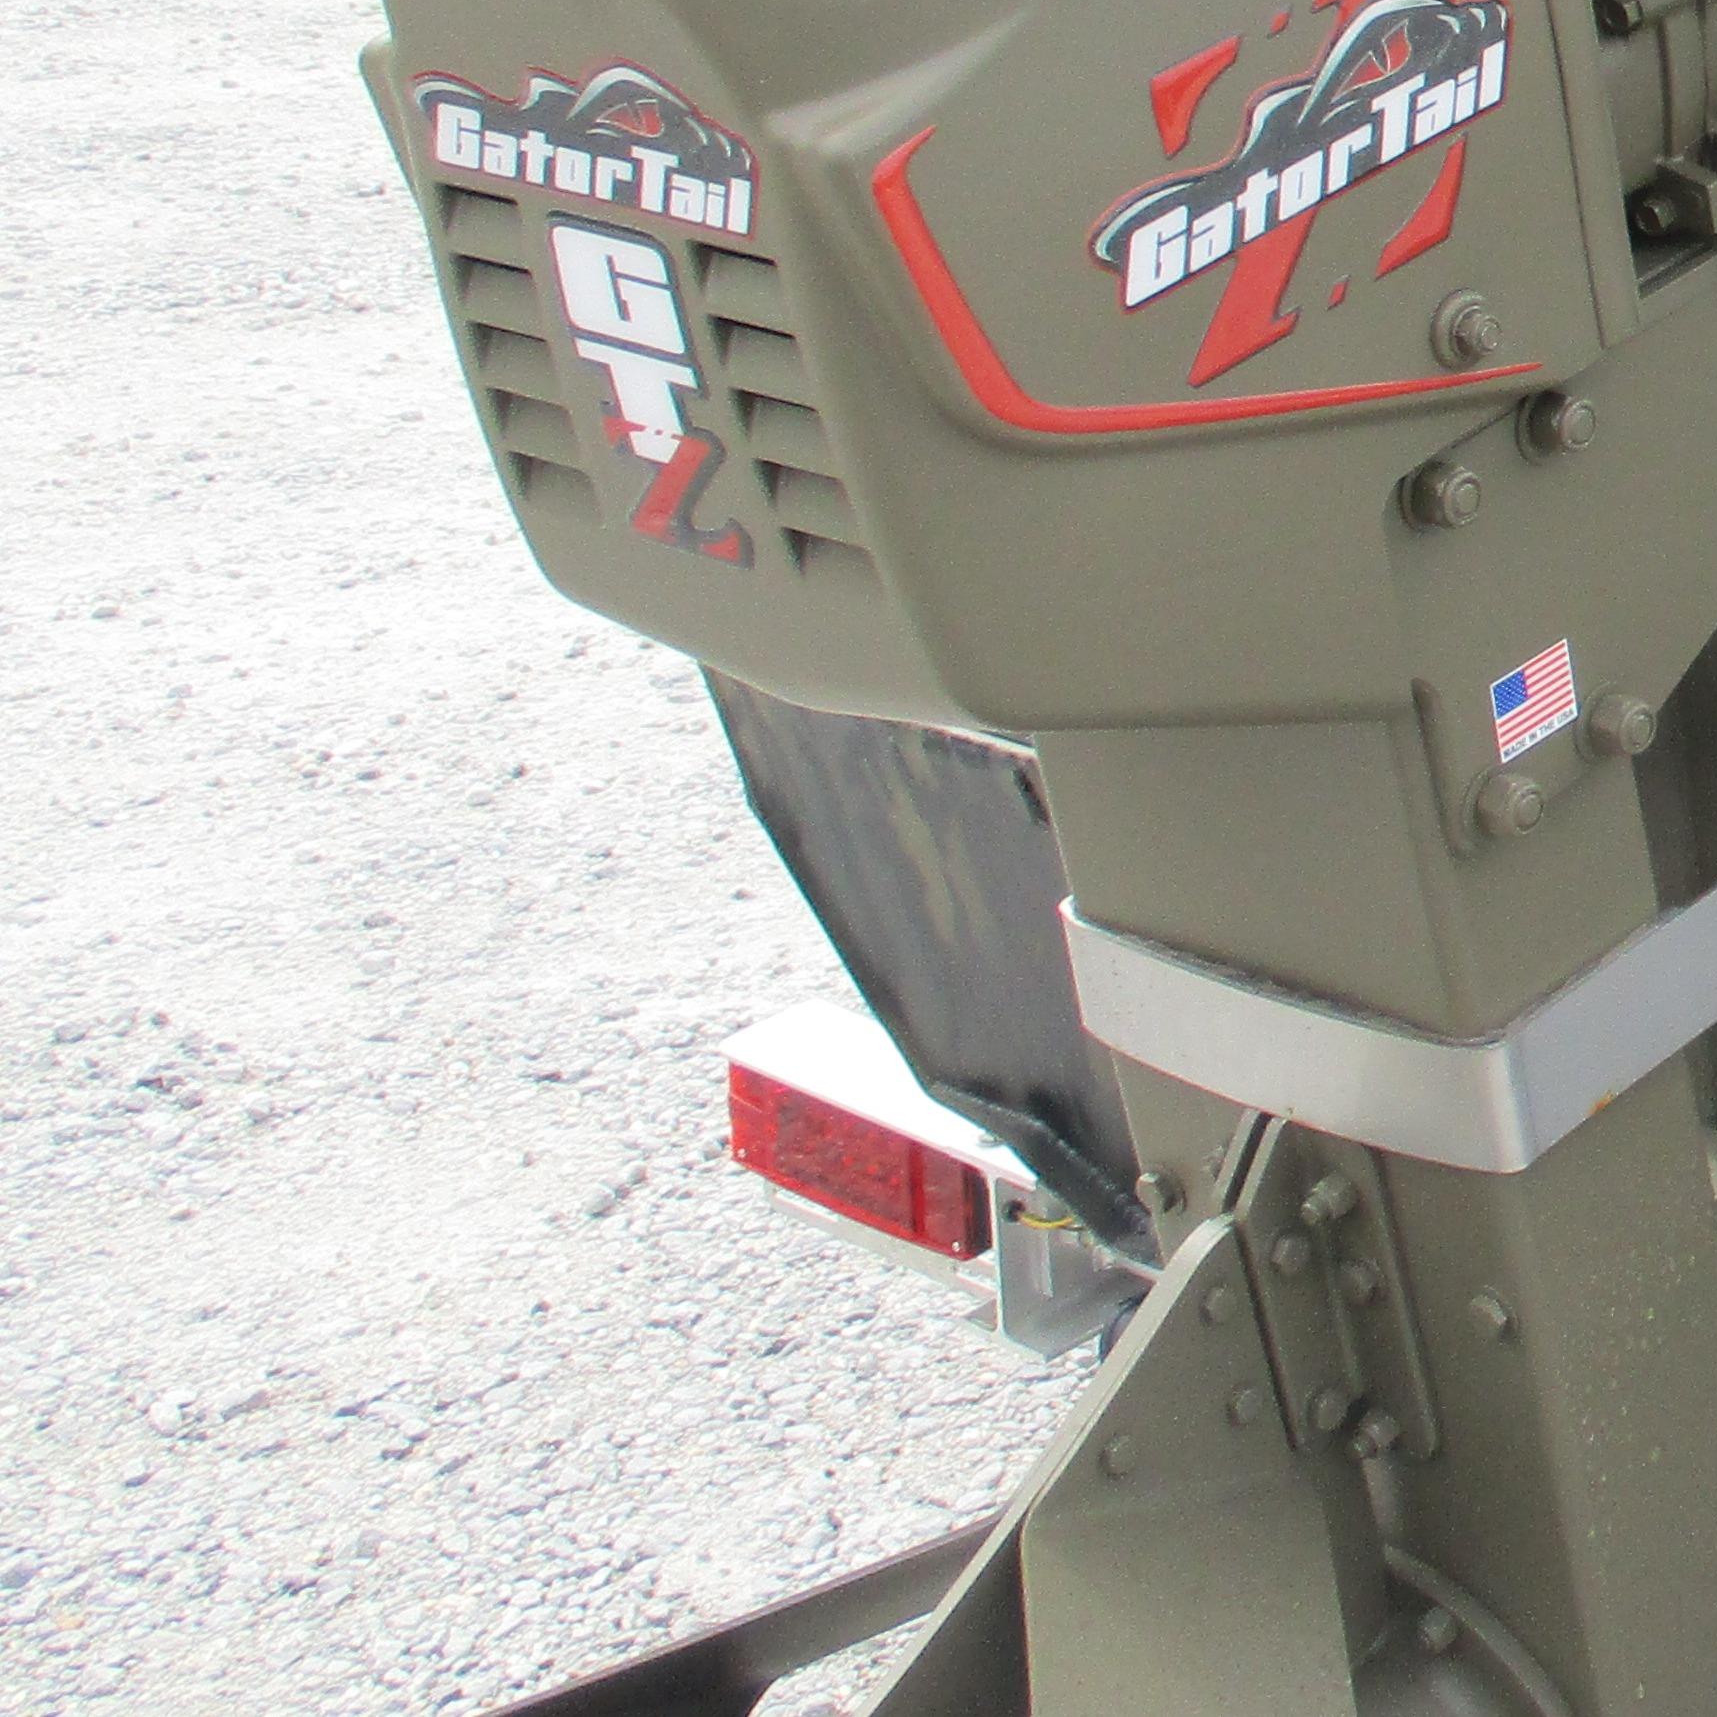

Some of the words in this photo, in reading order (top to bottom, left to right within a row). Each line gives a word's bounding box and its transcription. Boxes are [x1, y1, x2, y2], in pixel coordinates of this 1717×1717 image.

[435, 101, 752, 236] GatorTail
[1125, 39, 1507, 309] GatorTail
[1504, 737, 1526, 759] MADE
[1539, 718, 1556, 735] THE
[1556, 707, 1574, 725] USA
